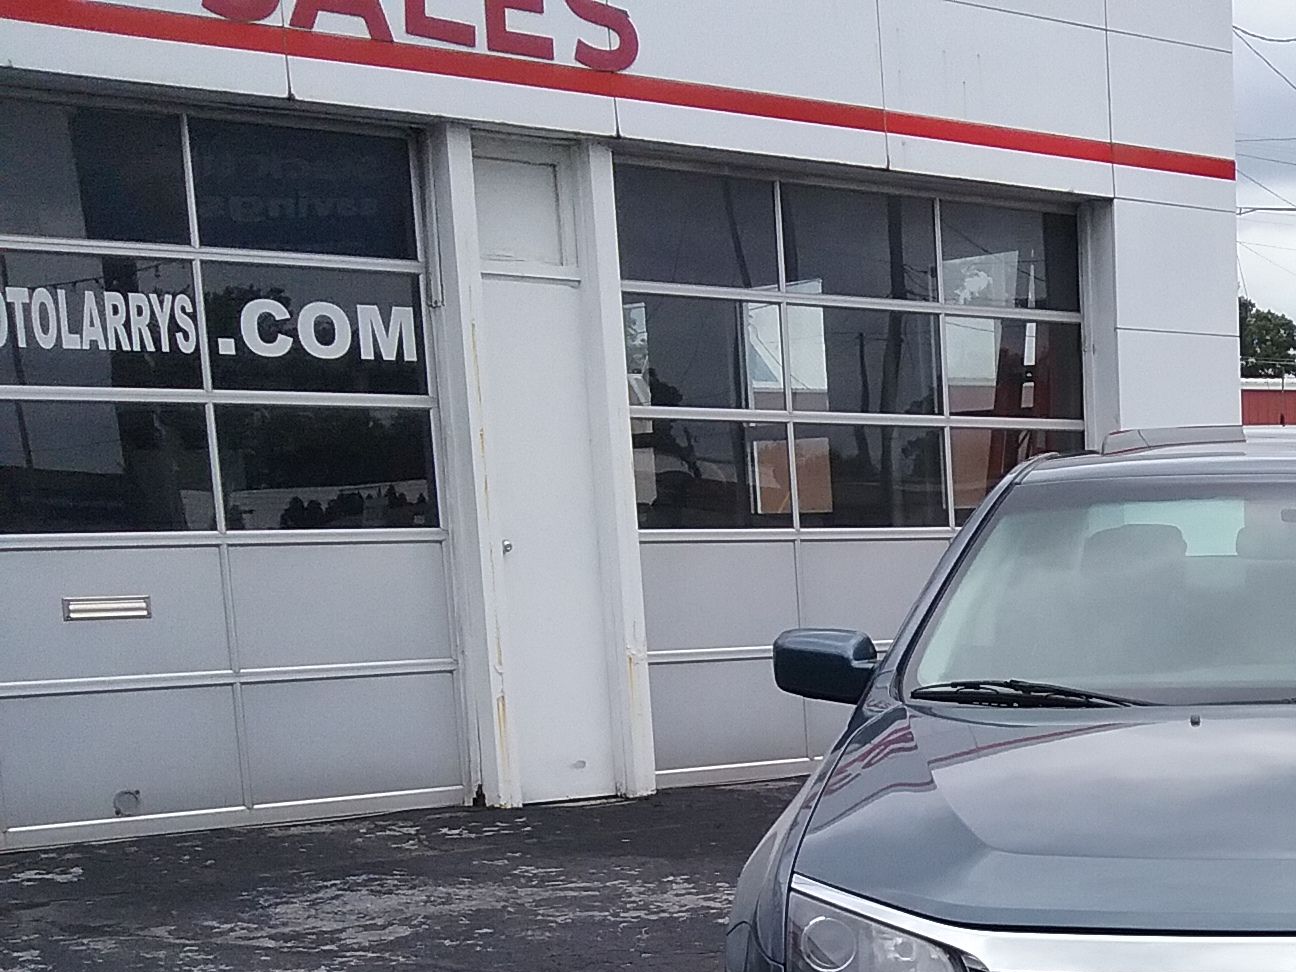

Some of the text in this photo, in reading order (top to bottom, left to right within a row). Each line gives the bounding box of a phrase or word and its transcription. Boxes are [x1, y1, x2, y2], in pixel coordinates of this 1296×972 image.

[202, 0, 639, 72] LES
[0, 286, 418, 362] TOLARRYS .COM
